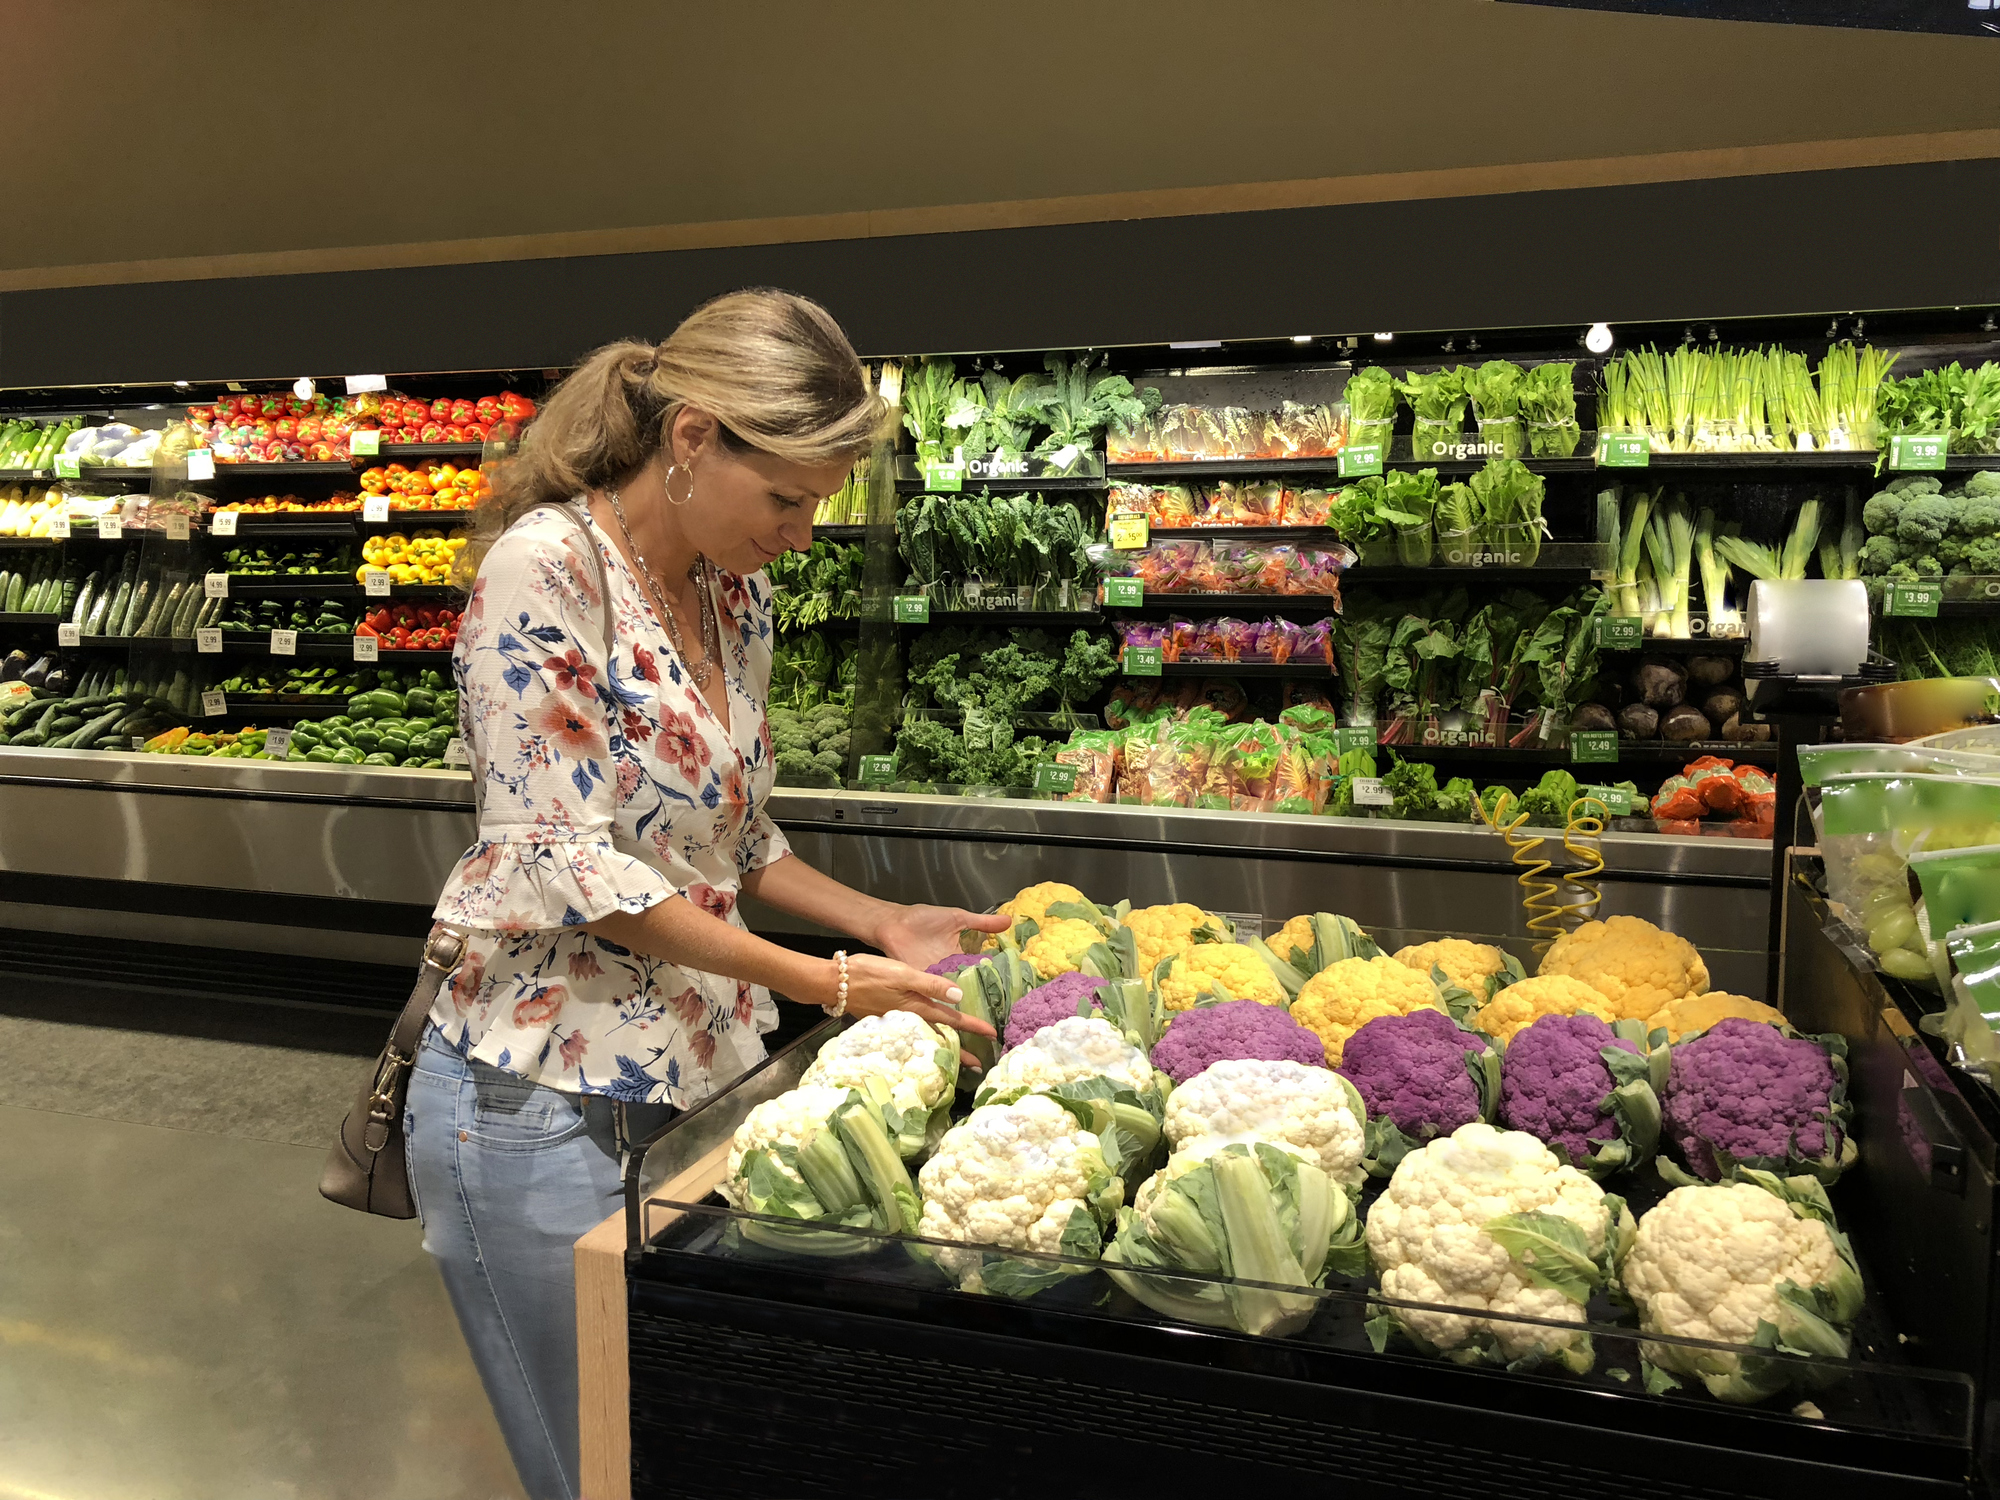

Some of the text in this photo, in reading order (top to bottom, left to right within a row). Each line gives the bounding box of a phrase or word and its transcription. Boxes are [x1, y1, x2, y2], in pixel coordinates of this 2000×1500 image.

[1431, 439, 1504, 460] Organic
[1619, 443, 1641, 454] $1.99
[1912, 445, 1938, 457] $3.99
[1353, 453, 1375, 464] $2.99
[969, 460, 1028, 477] Organic
[1448, 549, 1521, 568] Organic
[1117, 585, 1136, 595] $2.99
[966, 593, 1025, 610] Organic
[1904, 592, 1929, 603] $3.99
[906, 603, 923, 613] $2.99
[1611, 625, 1634, 636] $2.99
[1689, 618, 1747, 639] Organ
[1137, 655, 1155, 665] $3.49
[1349, 736, 1369, 746] $2.99
[1424, 727, 1496, 746] Organic
[1588, 740, 1610, 751] $2.49
[872, 763, 891, 772] $2.99
[1049, 771, 1069, 781] $2.99
[1361, 784, 1383, 795] $2.99
[1598, 792, 1622, 804] $2.99
